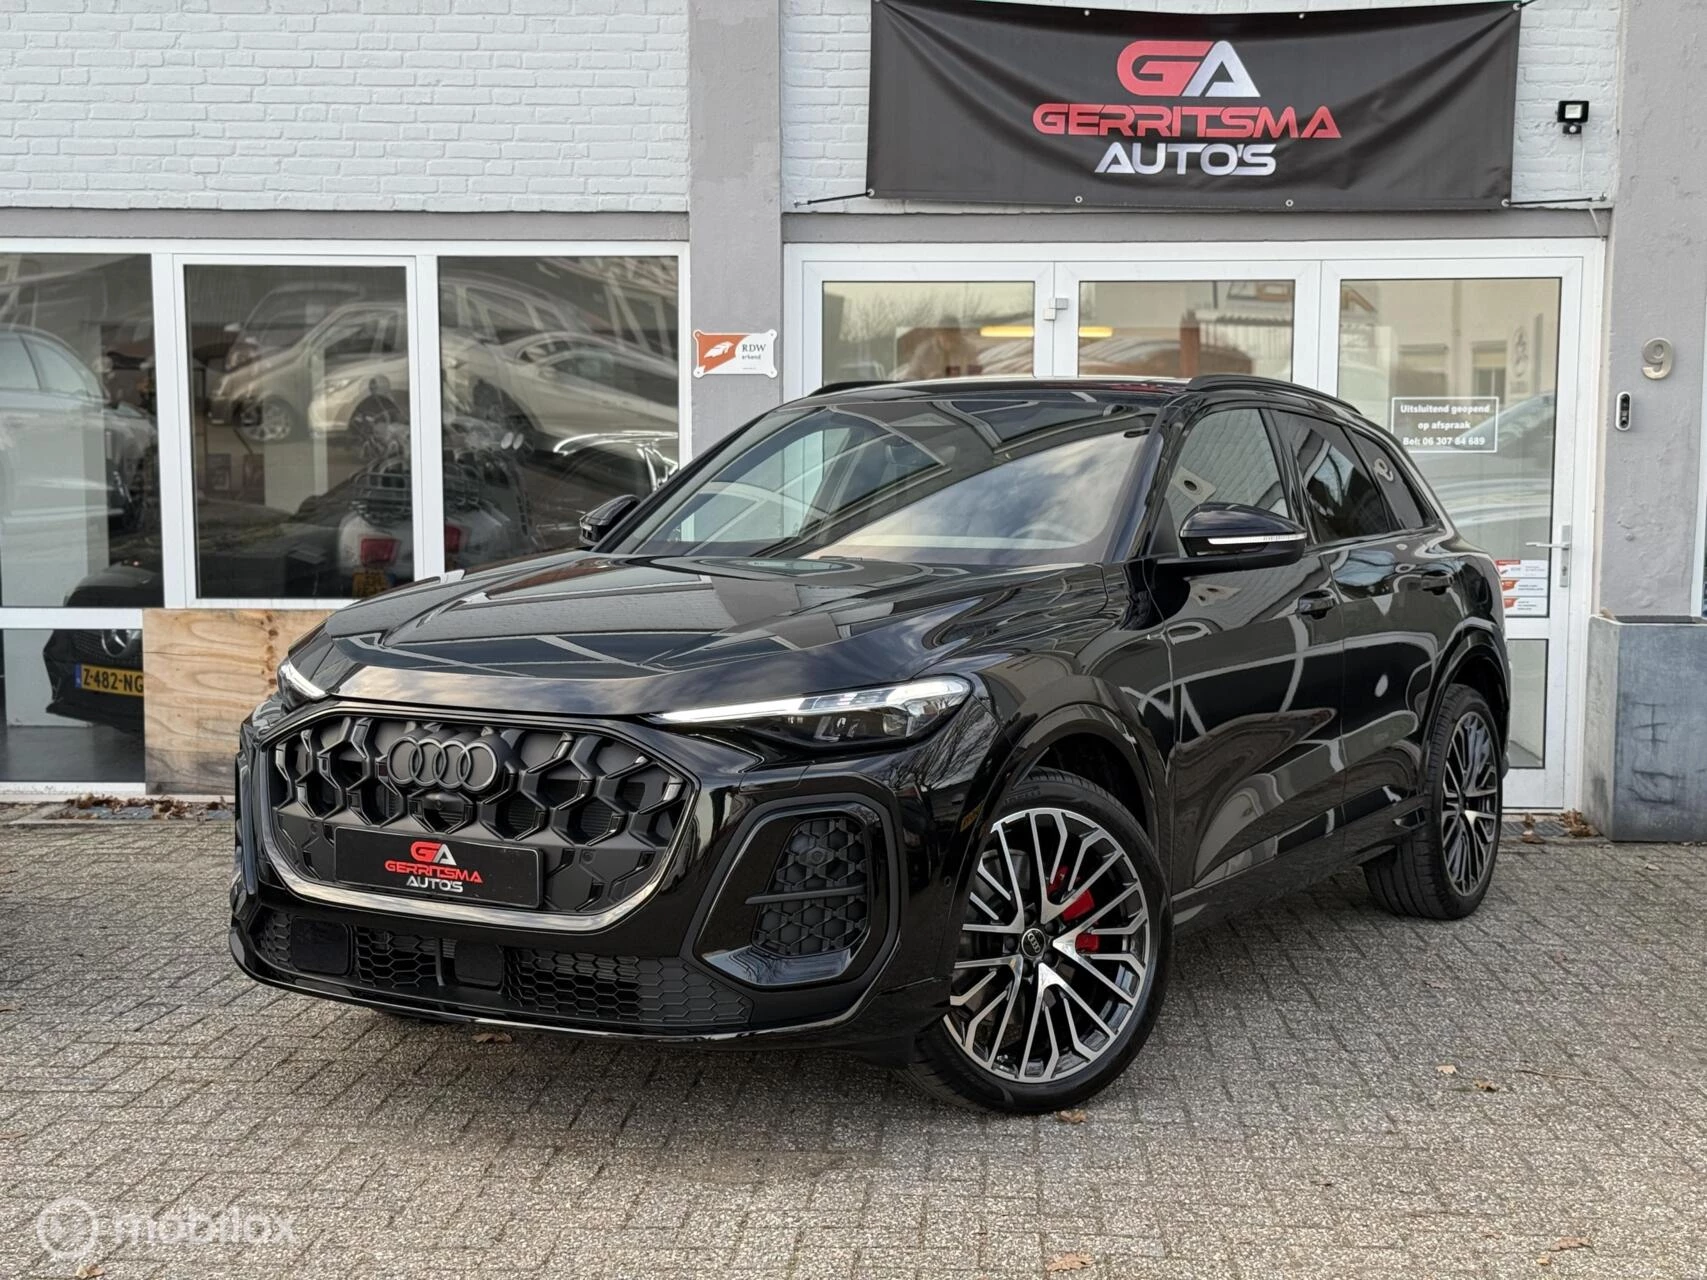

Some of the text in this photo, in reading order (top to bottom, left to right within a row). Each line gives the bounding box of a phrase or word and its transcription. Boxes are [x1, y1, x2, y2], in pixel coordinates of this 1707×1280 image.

[1116, 40, 1261, 98] GA
[1032, 103, 1342, 139] GERRITSMA
[1094, 141, 1277, 176] AUTO'S
[742, 343, 766, 353] RDW
[1642, 337, 1673, 380] 9
[1400, 404, 1490, 415] Uitsluitend geopend
[1418, 421, 1471, 431] op afspraak
[1402, 437, 1420, 446] Bel:
[1422, 437, 1434, 446] 06
[1436, 437, 1452, 446] 307
[83, 668, 144, 693] Z-482-NG
[410, 841, 457, 866] GA
[384, 860, 483, 884] GERRITSMA
[406, 875, 464, 893] AUTO'S
